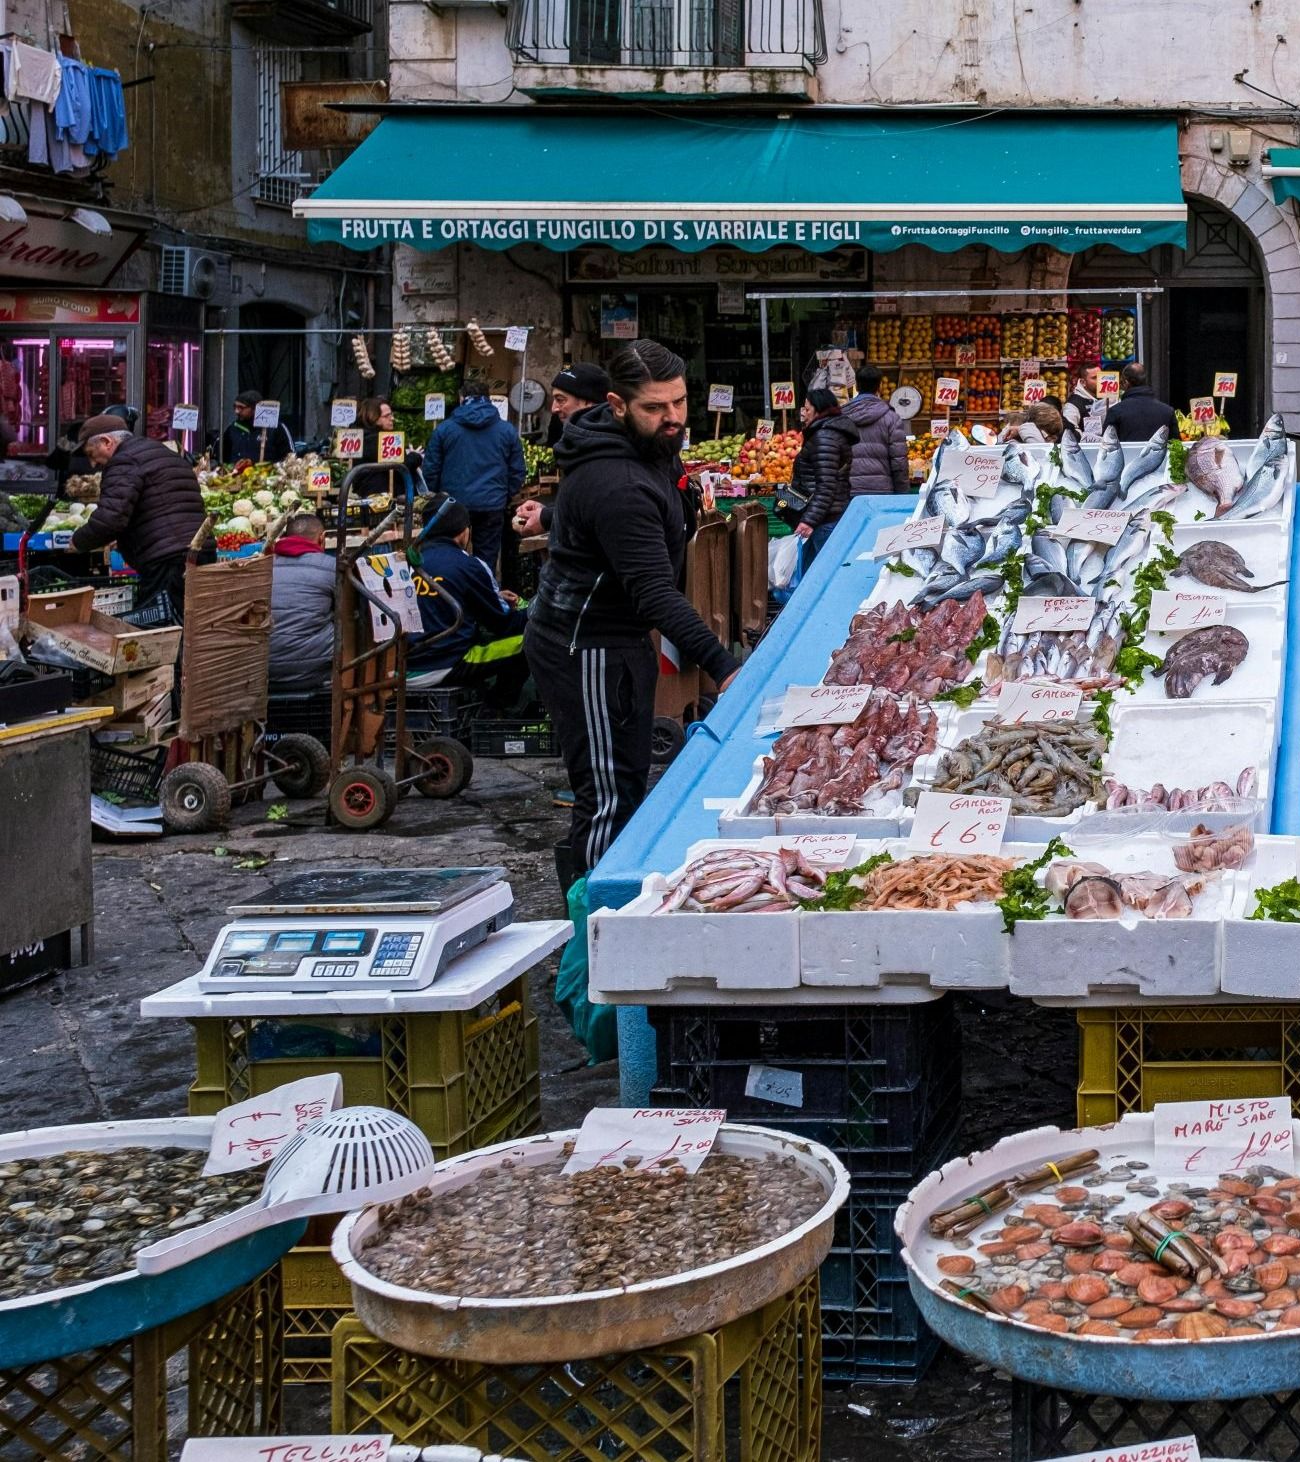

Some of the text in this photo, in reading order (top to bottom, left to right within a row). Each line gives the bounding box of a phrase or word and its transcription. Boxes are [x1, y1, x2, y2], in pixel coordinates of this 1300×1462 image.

[341, 219, 861, 241] FRUTTA E ORTAGGI FUNGILLO DI S. VARRIALE E FIGLI
[1209, 1100, 1271, 1118] MISTO
